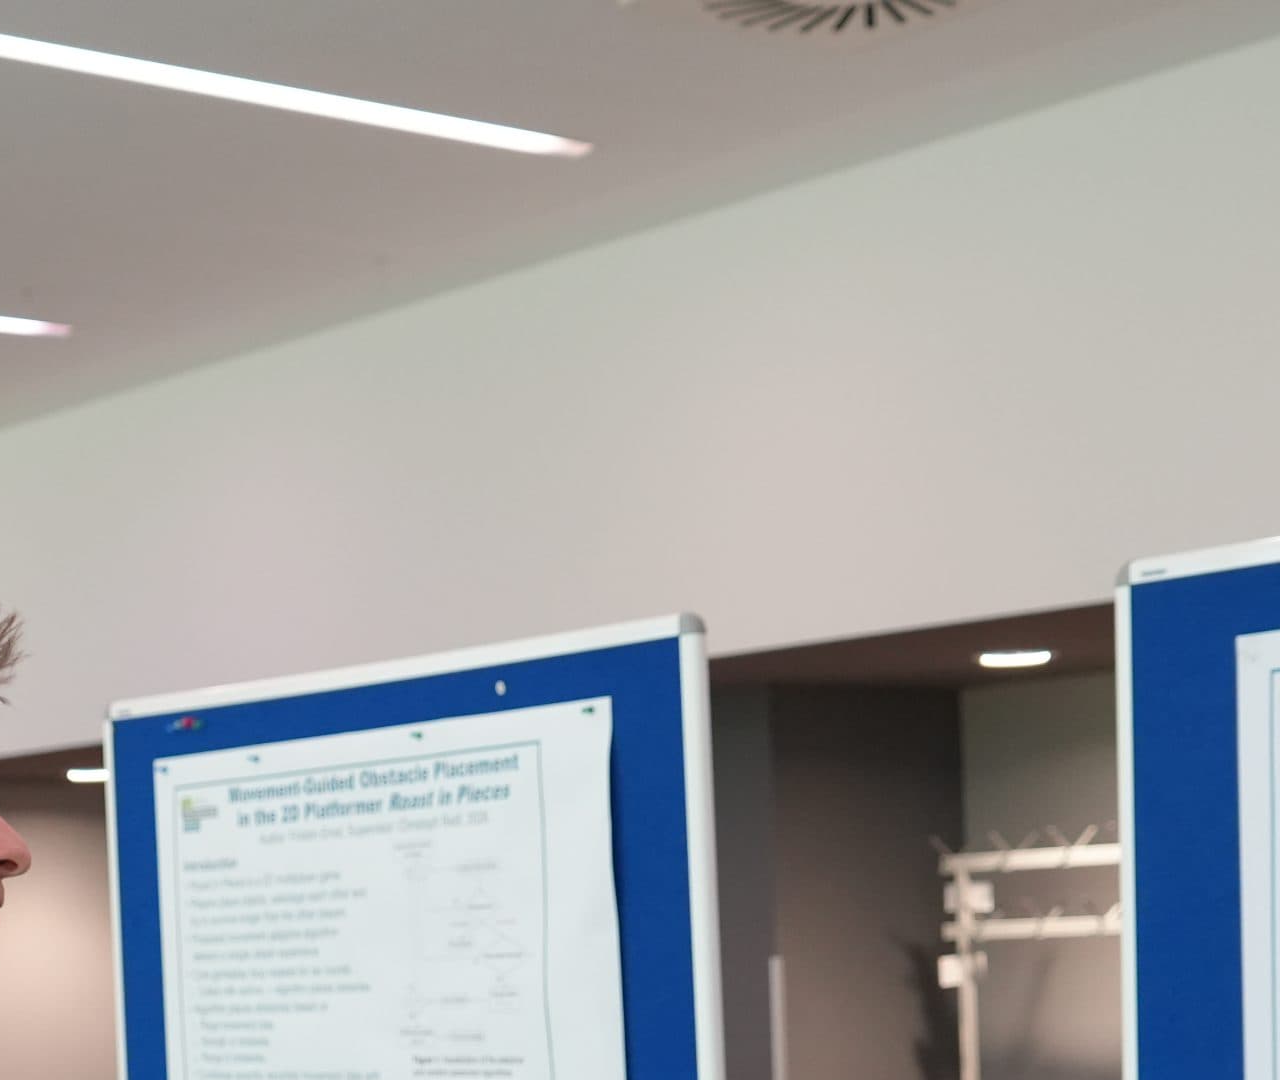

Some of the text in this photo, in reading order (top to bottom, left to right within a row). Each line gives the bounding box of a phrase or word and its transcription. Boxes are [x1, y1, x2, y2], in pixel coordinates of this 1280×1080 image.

[227, 752, 521, 804] Movement-Guided Obstacle Placement
[236, 806, 250, 828] in
[254, 802, 276, 826] the
[303, 794, 383, 820] Platformer
[388, 788, 434, 812] Roast
[456, 782, 512, 806] Pieces
